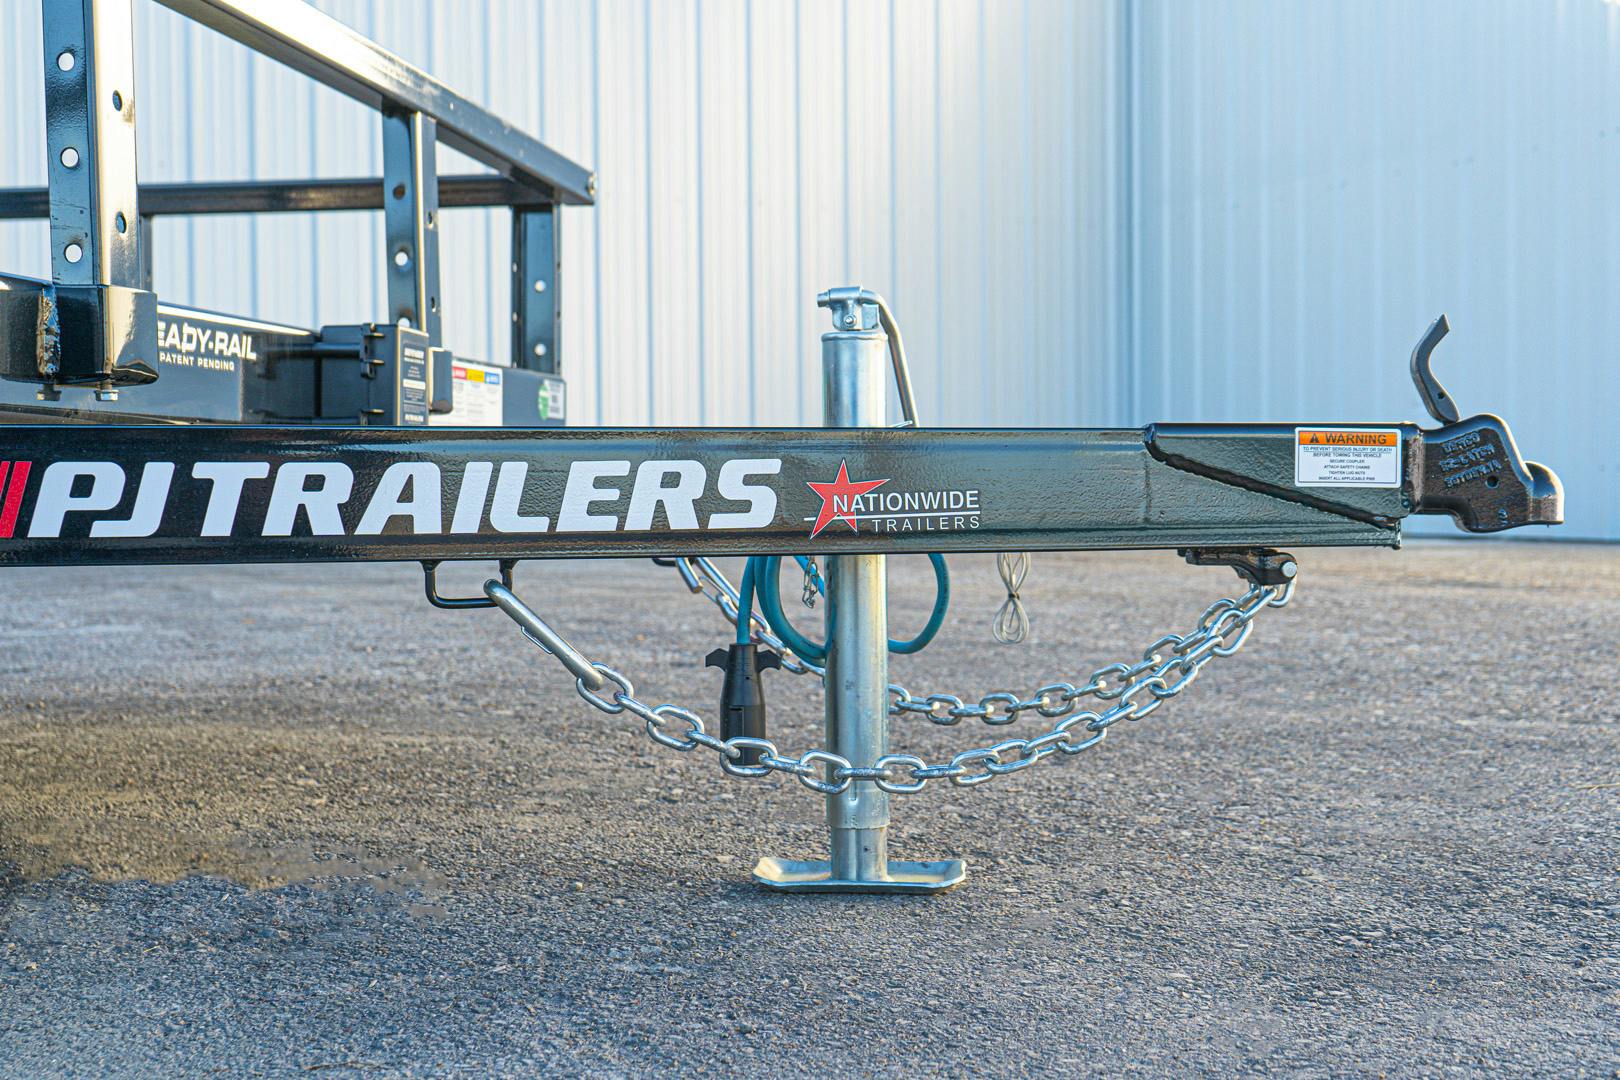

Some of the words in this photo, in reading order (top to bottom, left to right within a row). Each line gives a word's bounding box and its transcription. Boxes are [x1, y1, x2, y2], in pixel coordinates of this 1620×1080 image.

[160, 351, 195, 367] PATENT
[197, 356, 235, 372] PENDING
[1325, 433, 1387, 445] WARNING
[27, 461, 175, 538] PJ
[192, 458, 782, 537] TRAILERS
[833, 490, 980, 513] NATIONWIDE
[872, 515, 980, 533] TRAILERS
